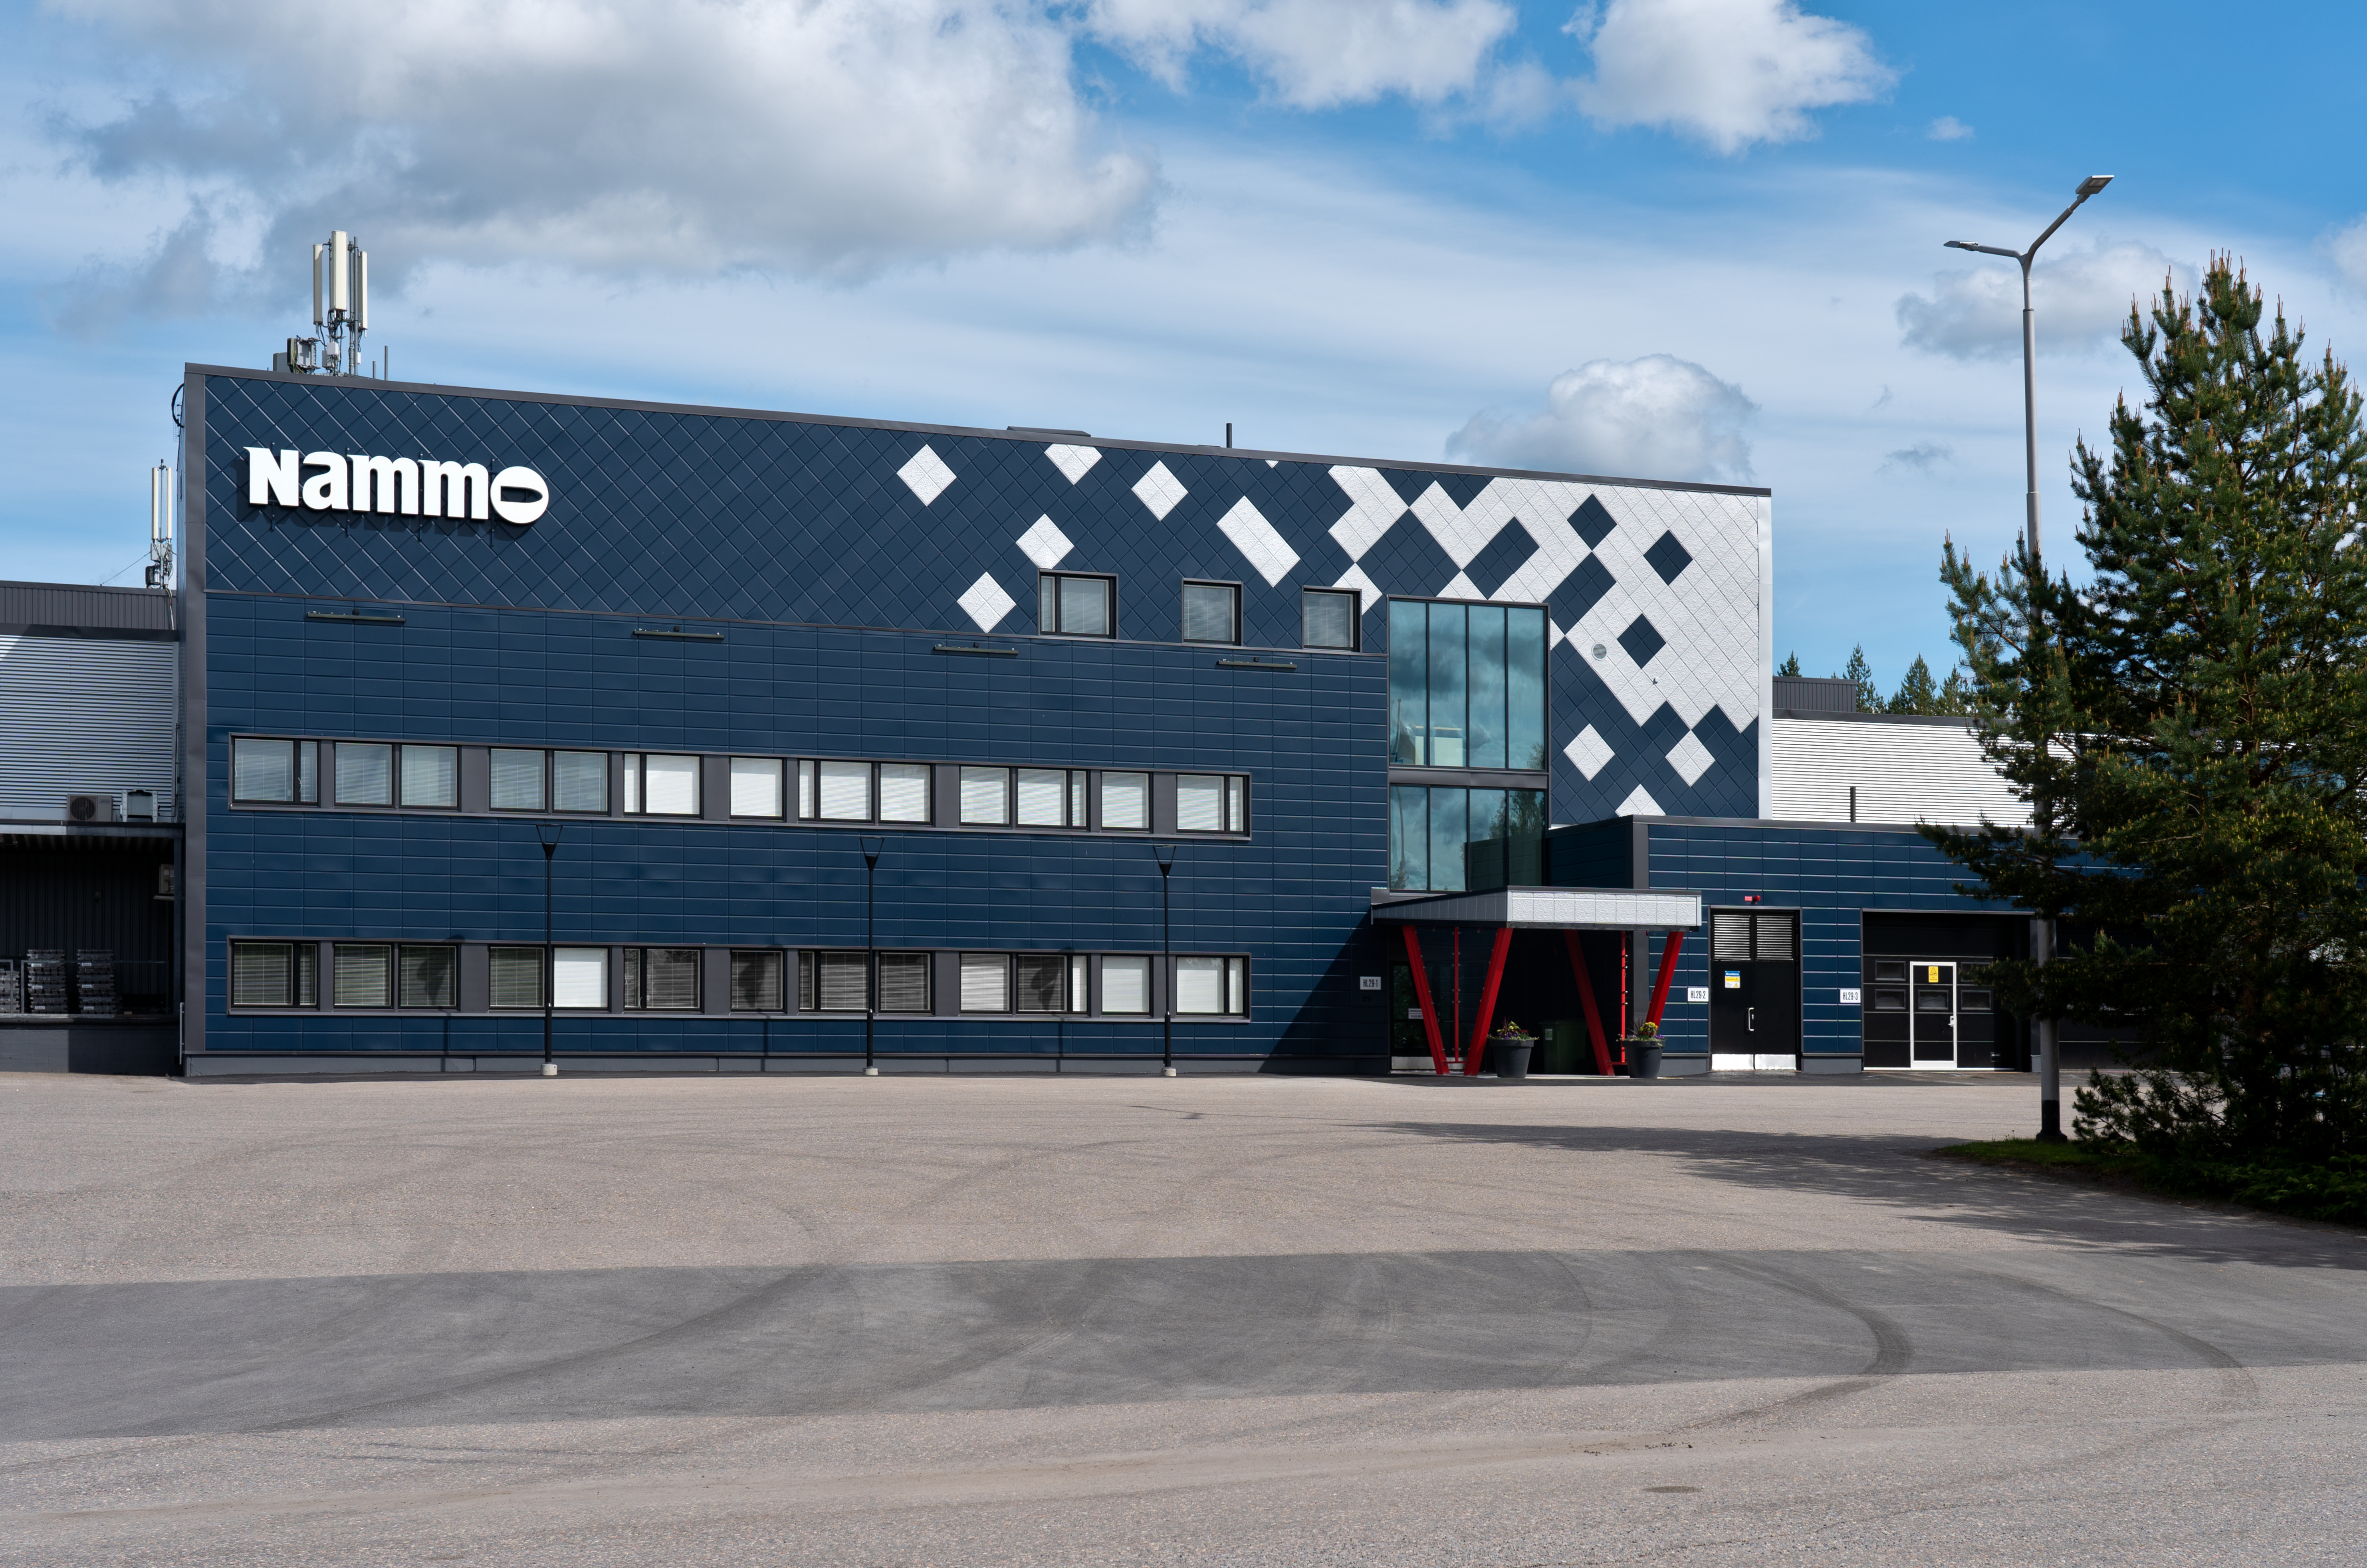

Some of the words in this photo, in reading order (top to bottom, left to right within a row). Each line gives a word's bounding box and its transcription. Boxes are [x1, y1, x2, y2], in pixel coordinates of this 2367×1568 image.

[243, 446, 549, 524] Nammo
[1363, 979, 1378, 987] HL29-1
[1691, 990, 1706, 999] HL29-2
[1843, 992, 1858, 1000] HL29-3
